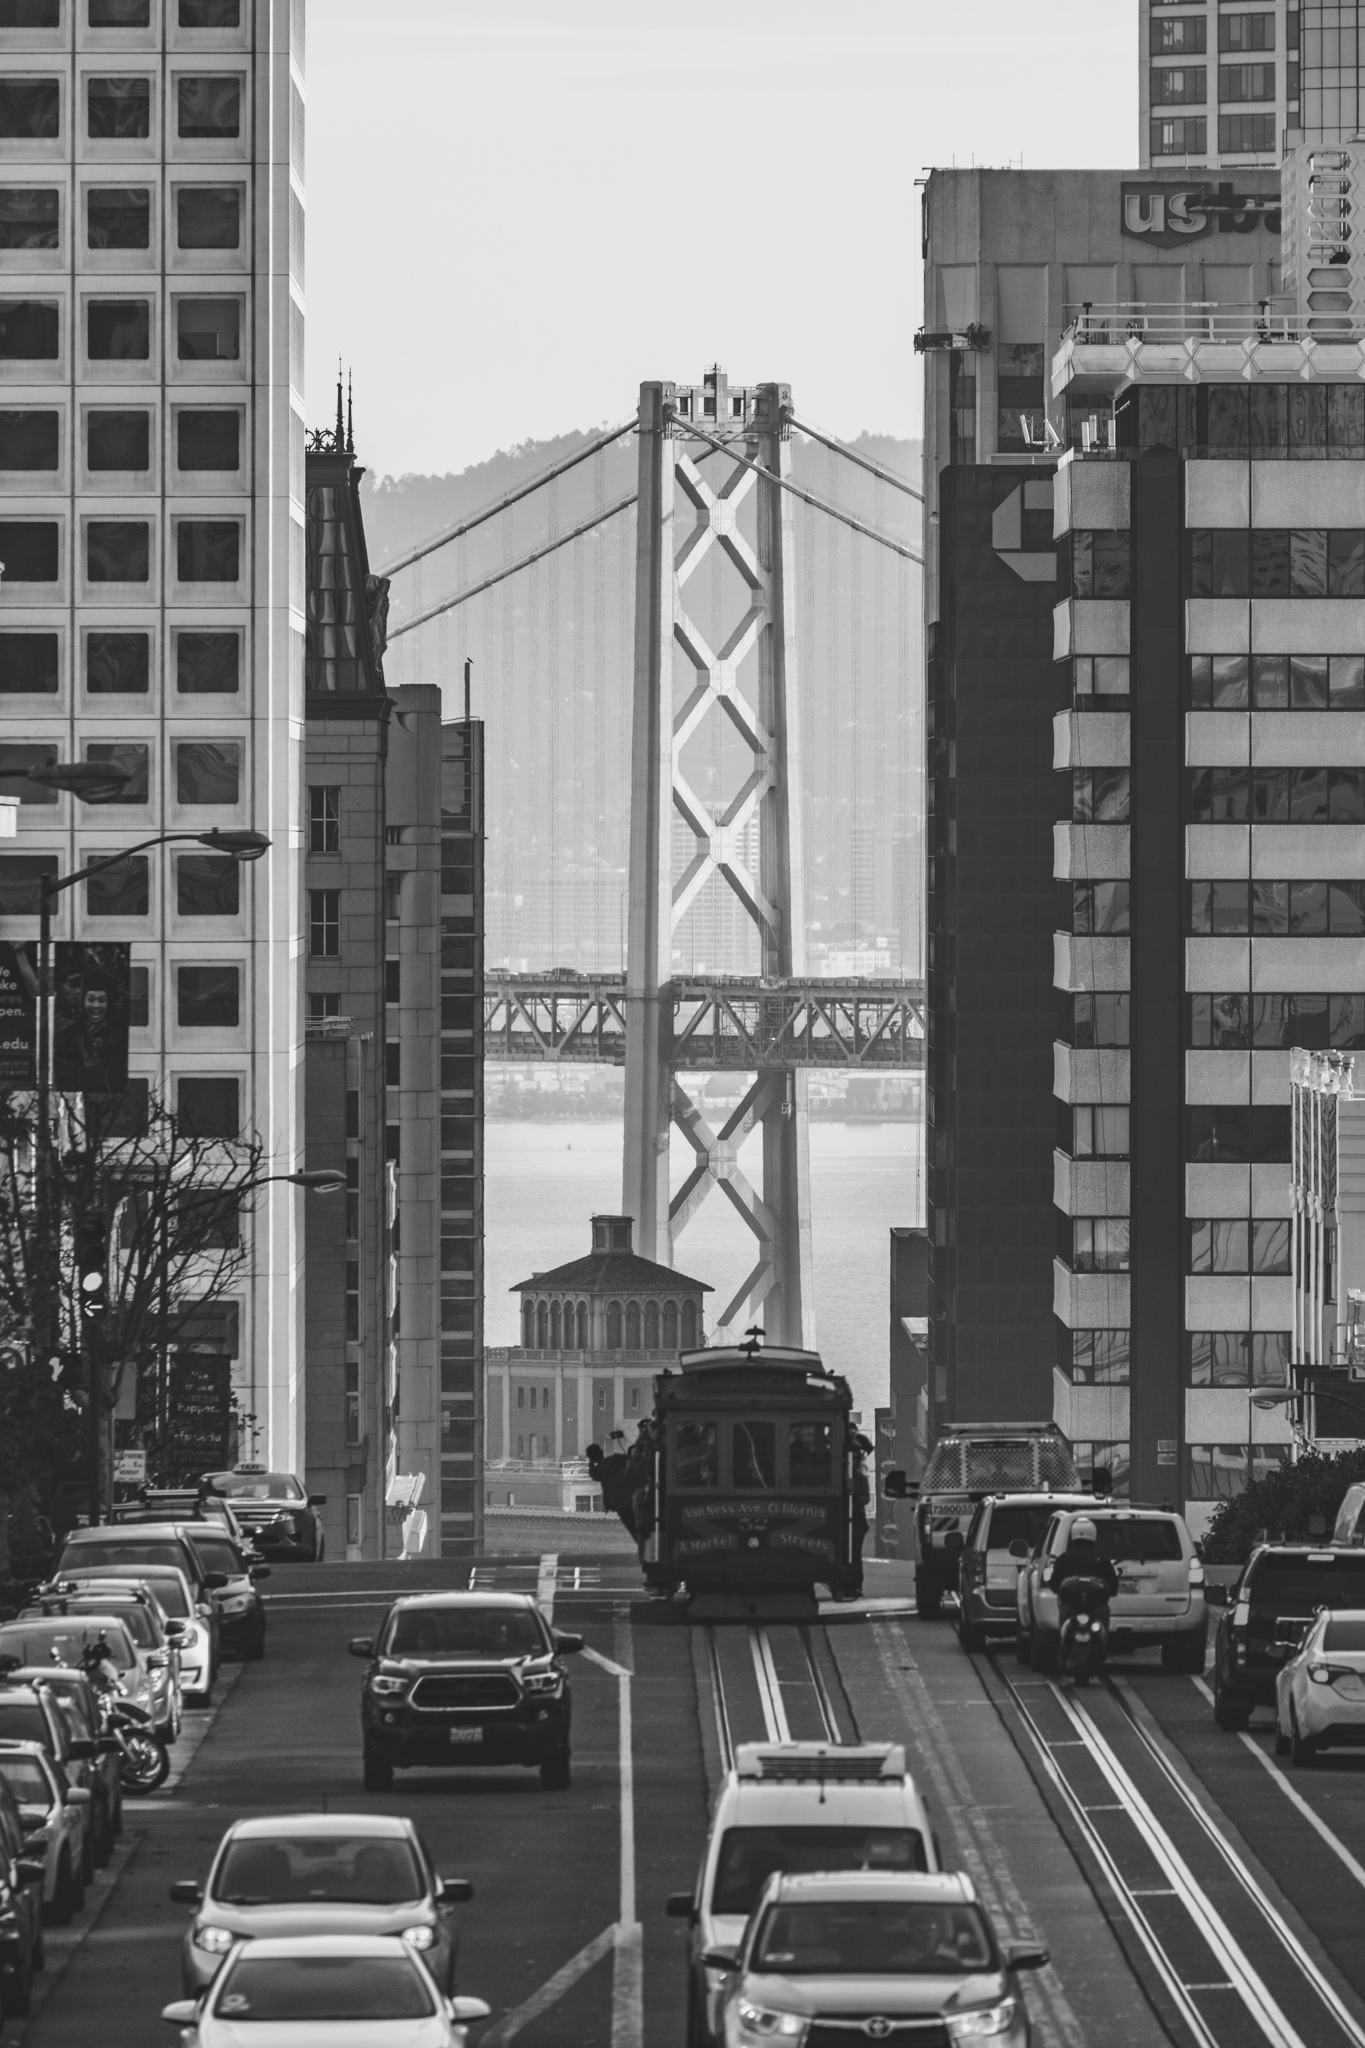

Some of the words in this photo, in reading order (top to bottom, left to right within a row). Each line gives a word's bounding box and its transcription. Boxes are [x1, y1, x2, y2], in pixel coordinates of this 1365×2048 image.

[1125, 192, 1207, 233] us
[0, 966, 10, 977] e
[0, 979, 17, 990] ke
[705, 1504, 735, 1515] Ness
[690, 1535, 733, 1551] Market
[779, 1532, 829, 1551] Streets
